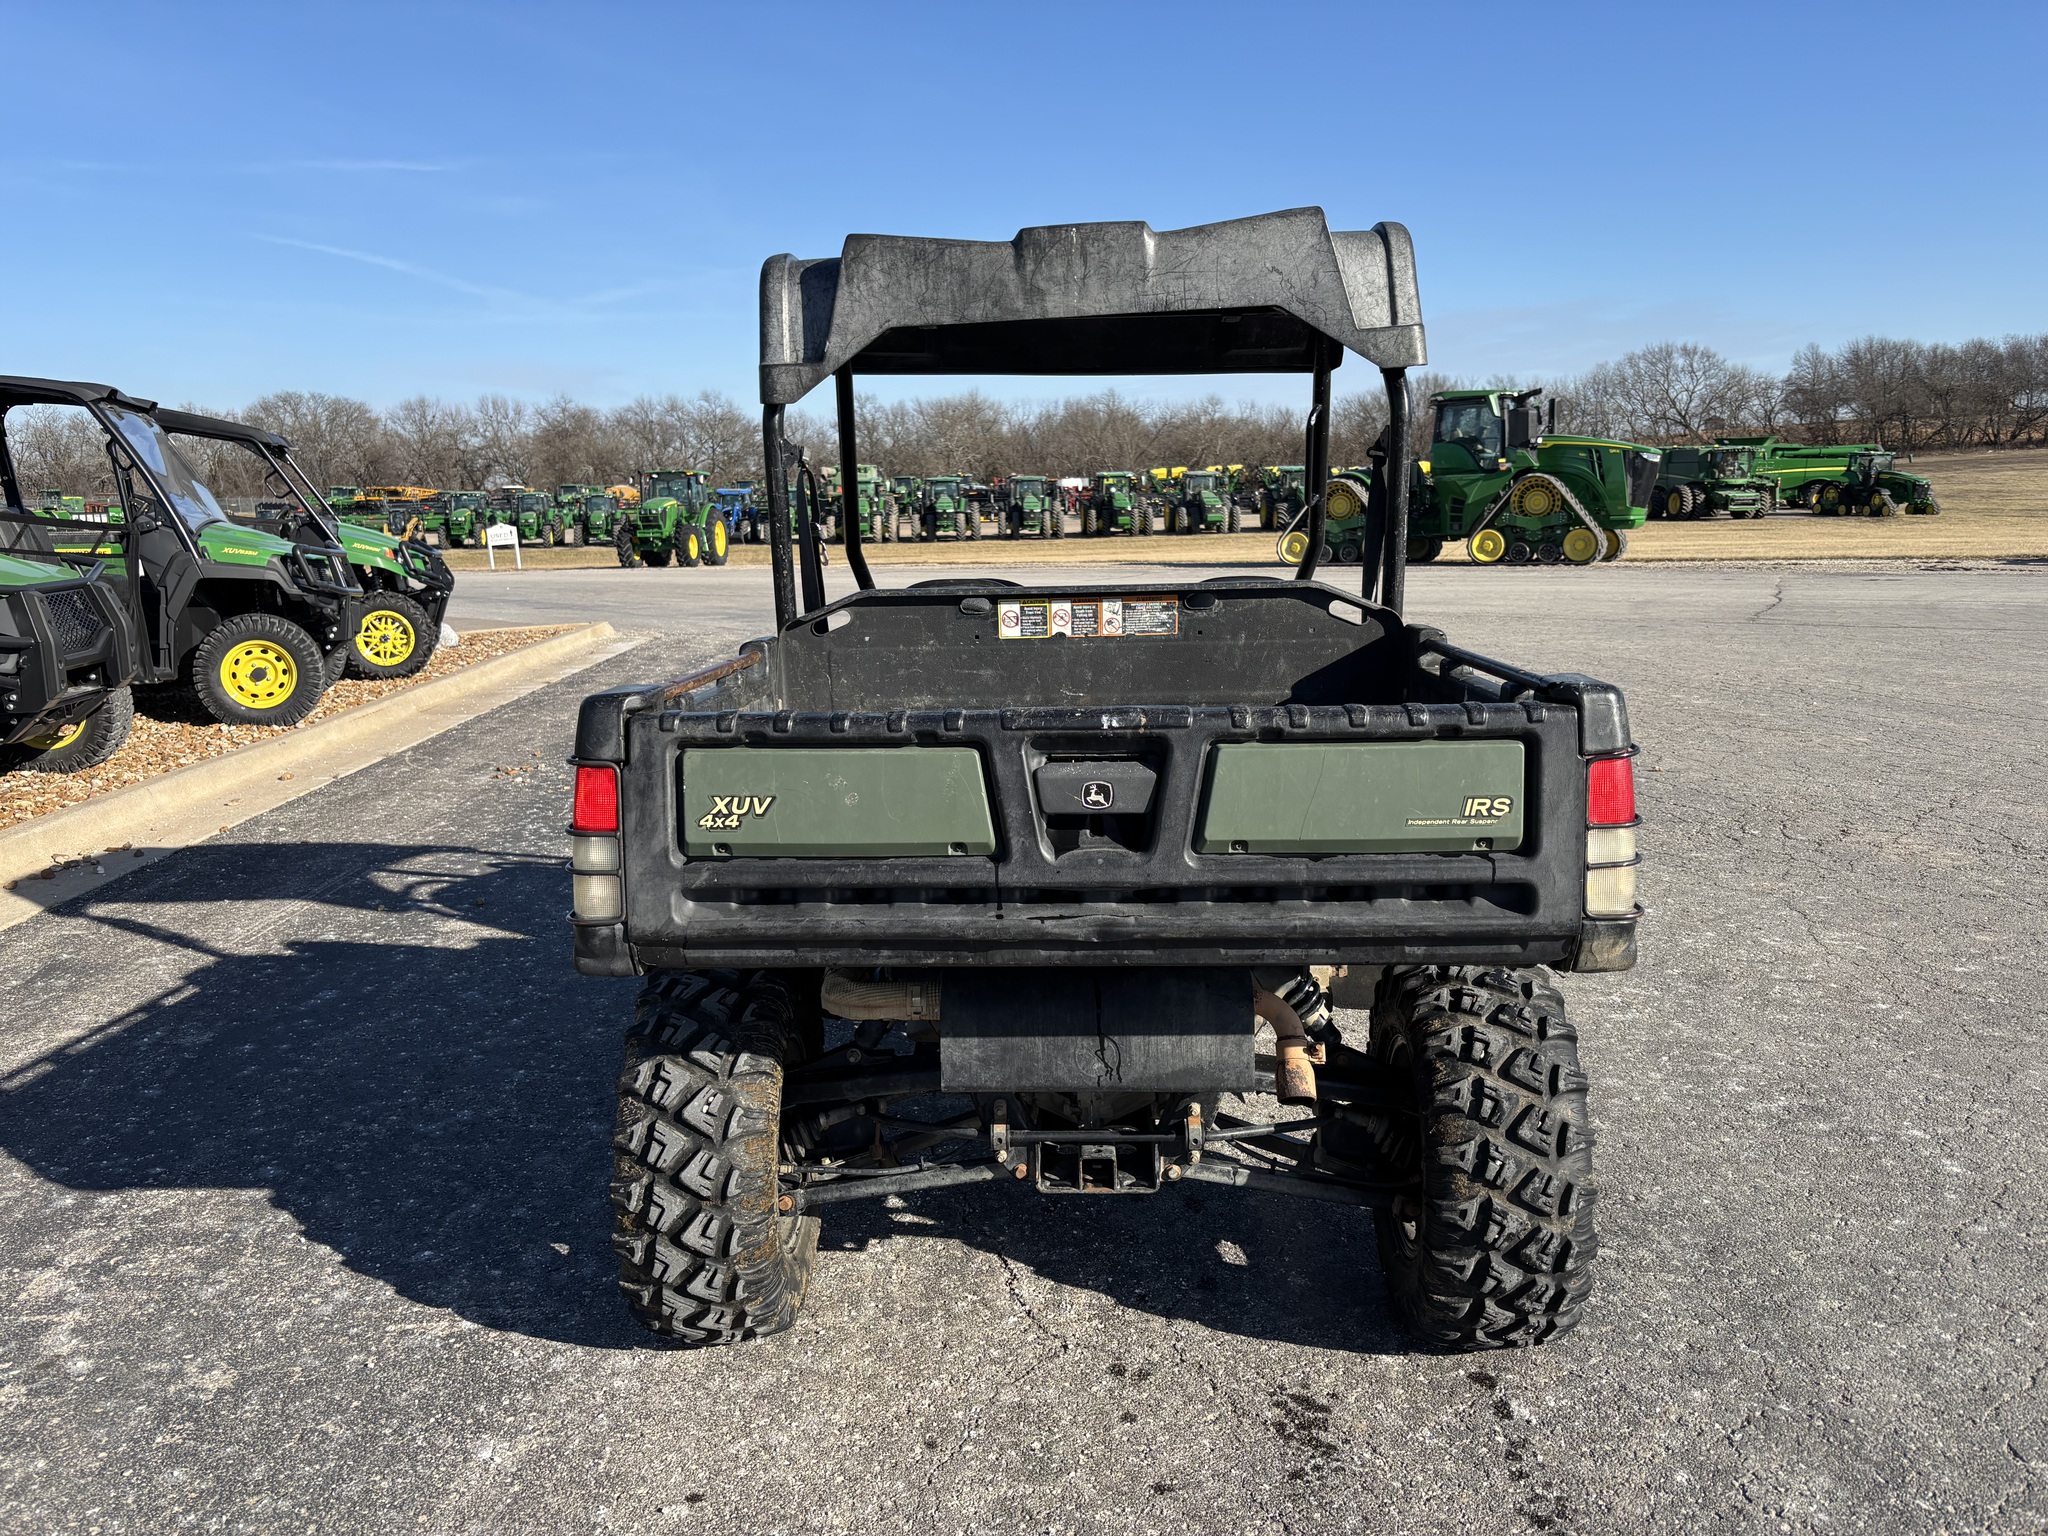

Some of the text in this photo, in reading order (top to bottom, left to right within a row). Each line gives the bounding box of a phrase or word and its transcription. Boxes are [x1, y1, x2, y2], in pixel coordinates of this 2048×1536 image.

[709, 796, 773, 815] XUV
[1464, 798, 1512, 816] IRS
[699, 814, 740, 828] 4x4
